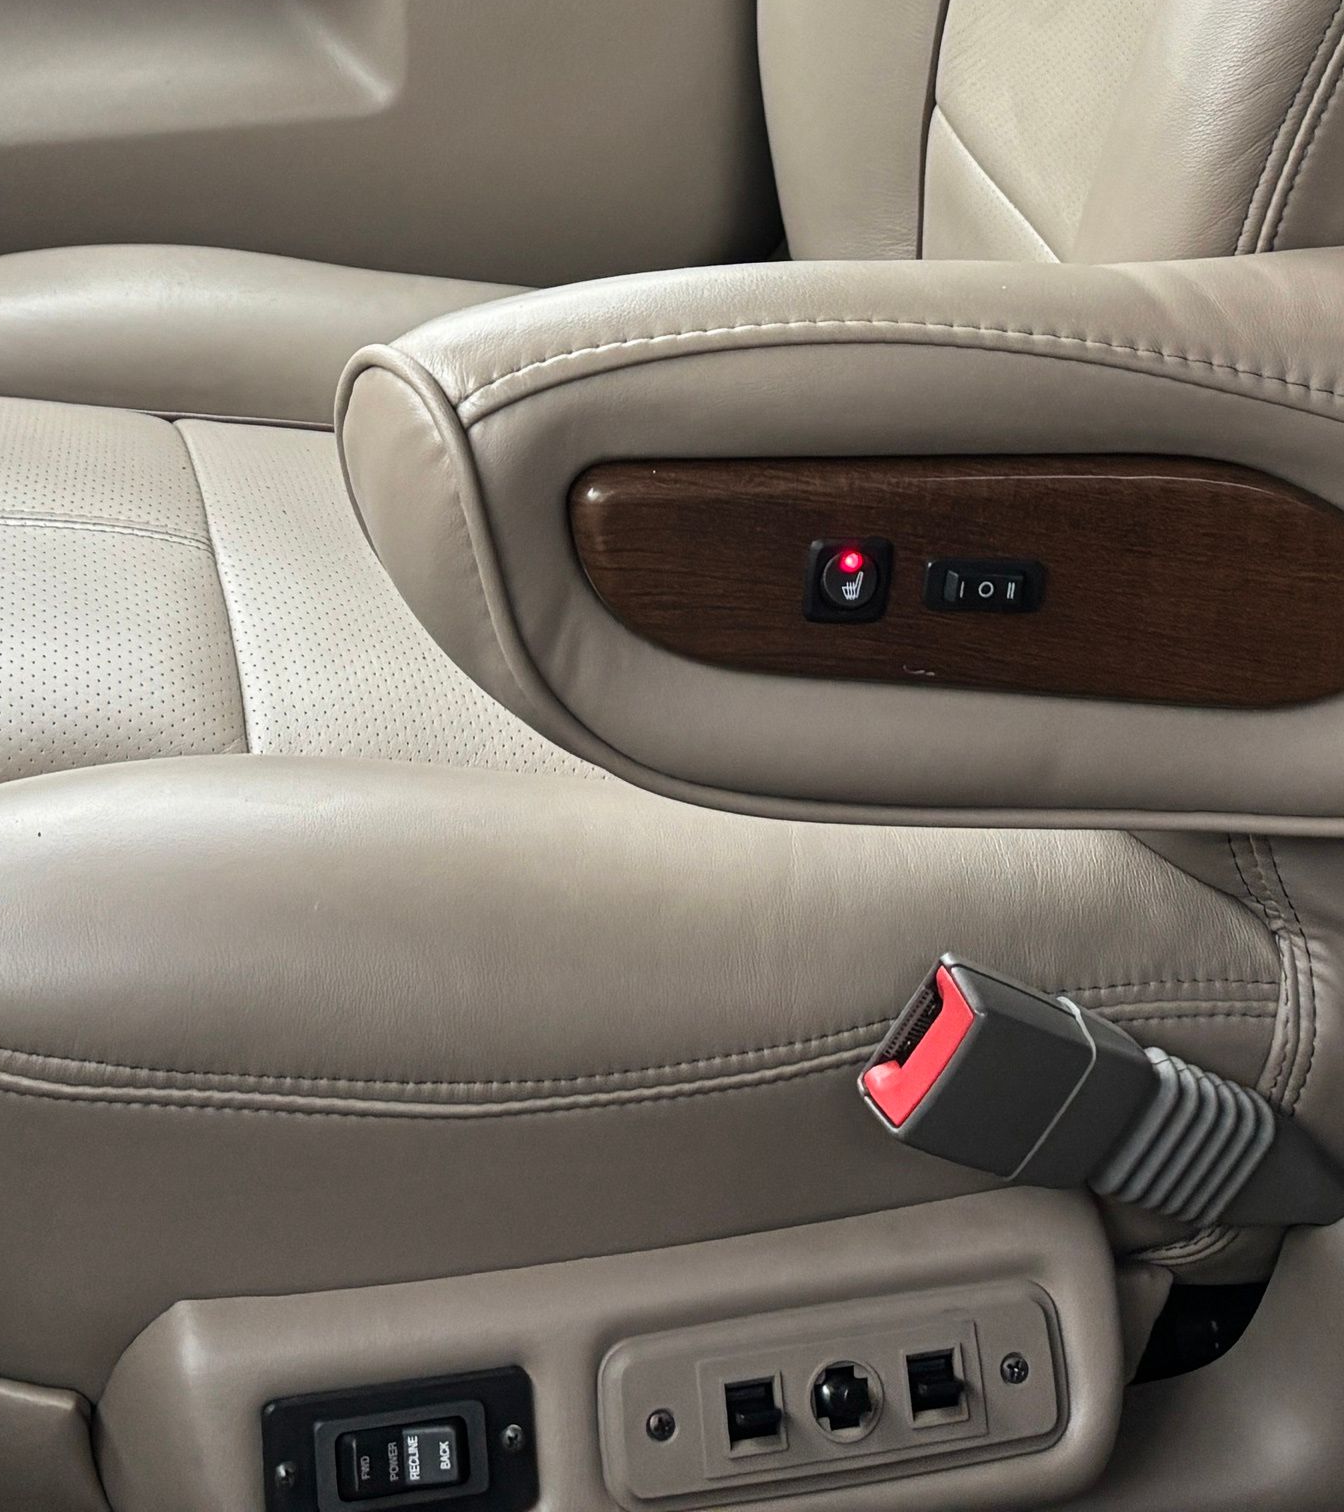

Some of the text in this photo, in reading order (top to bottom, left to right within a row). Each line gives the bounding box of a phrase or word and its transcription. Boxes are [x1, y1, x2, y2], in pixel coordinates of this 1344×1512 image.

[360, 1455, 370, 1480] FWD
[388, 1441, 399, 1482] POWER
[407, 1435, 420, 1481] RECLINE
[439, 1440, 451, 1470] BACK
